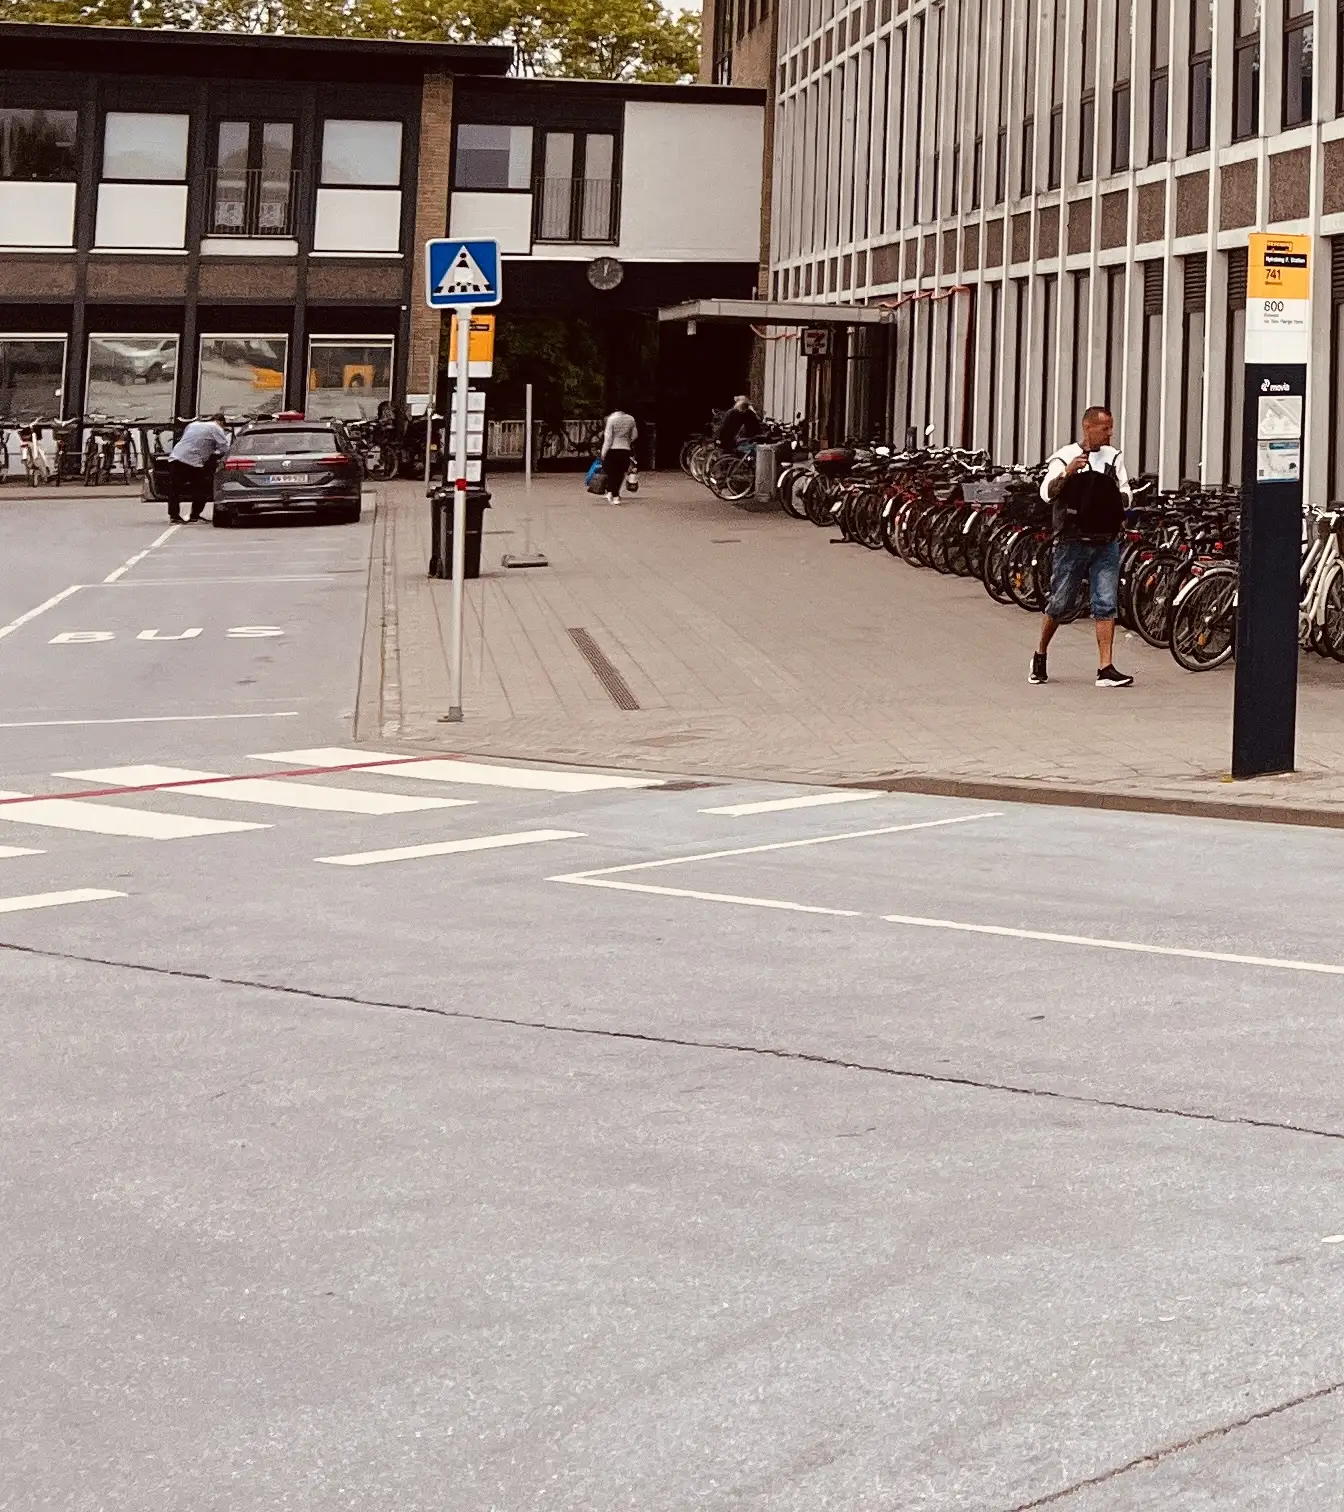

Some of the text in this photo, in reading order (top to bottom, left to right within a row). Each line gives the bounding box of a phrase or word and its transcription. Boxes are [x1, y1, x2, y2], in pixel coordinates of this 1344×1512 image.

[1265, 268, 1281, 281] 741
[1264, 300, 1284, 312] 800
[1269, 382, 1290, 392] movia
[47, 624, 285, 645] BUS
